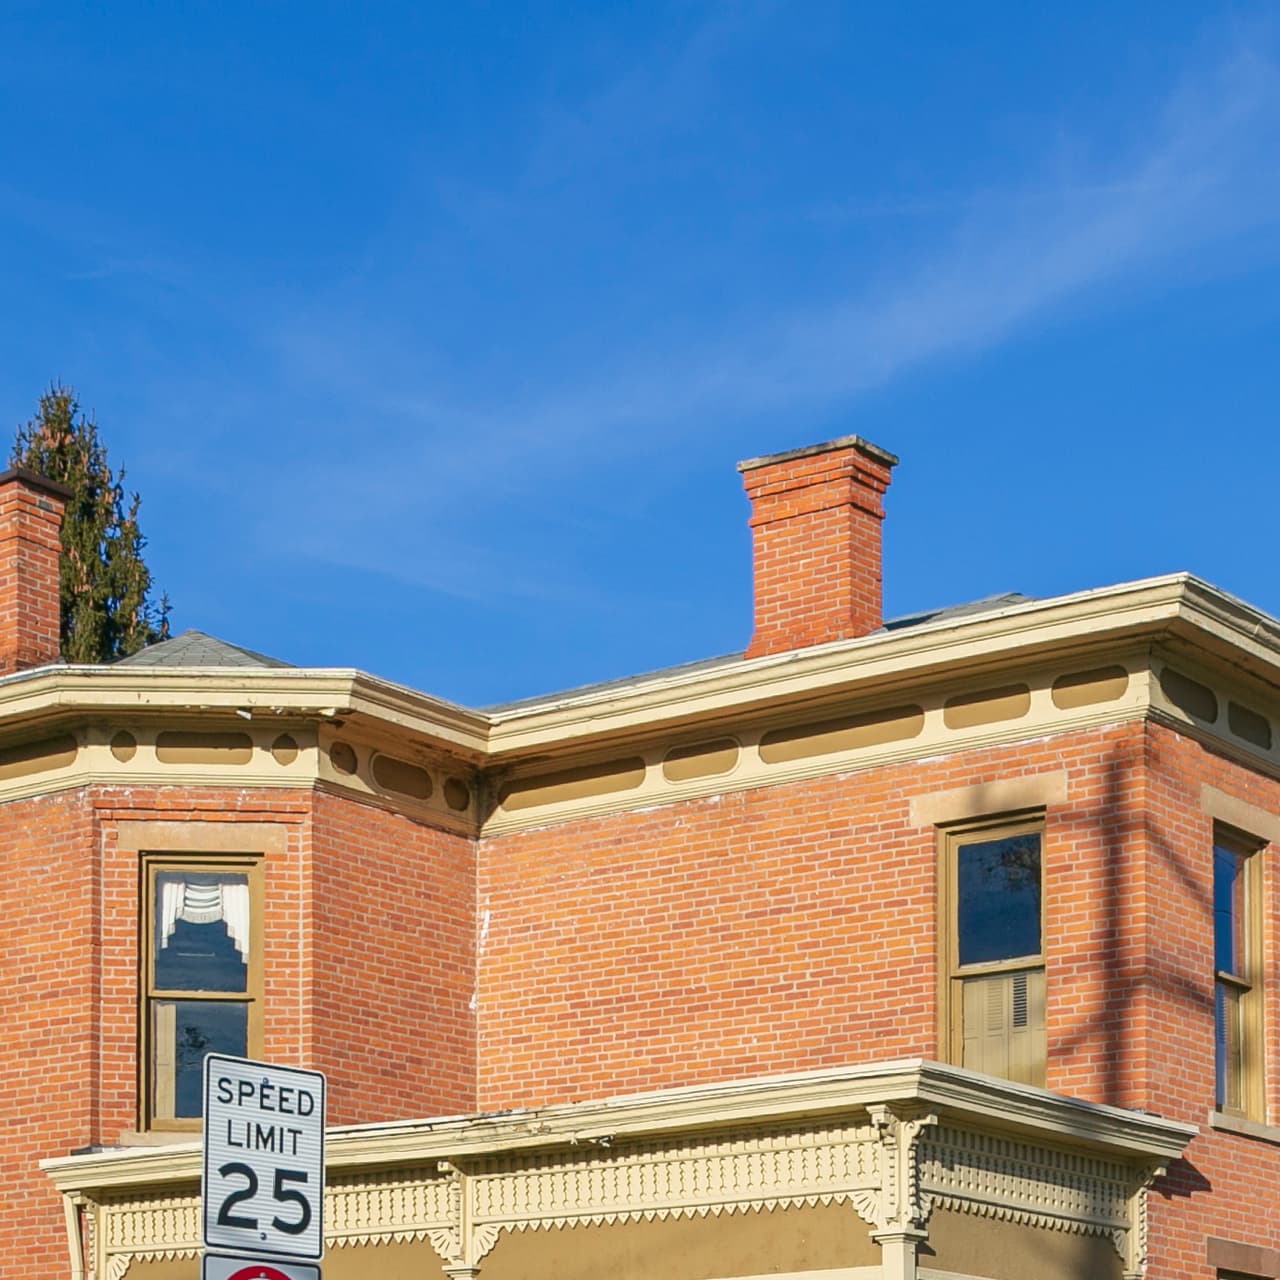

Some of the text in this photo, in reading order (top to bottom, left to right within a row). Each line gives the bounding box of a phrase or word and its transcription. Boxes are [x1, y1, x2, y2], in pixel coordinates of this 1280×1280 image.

[217, 1077, 314, 1117] SPEED
[227, 1119, 303, 1155] LIMIT
[217, 1162, 312, 1235] 25
